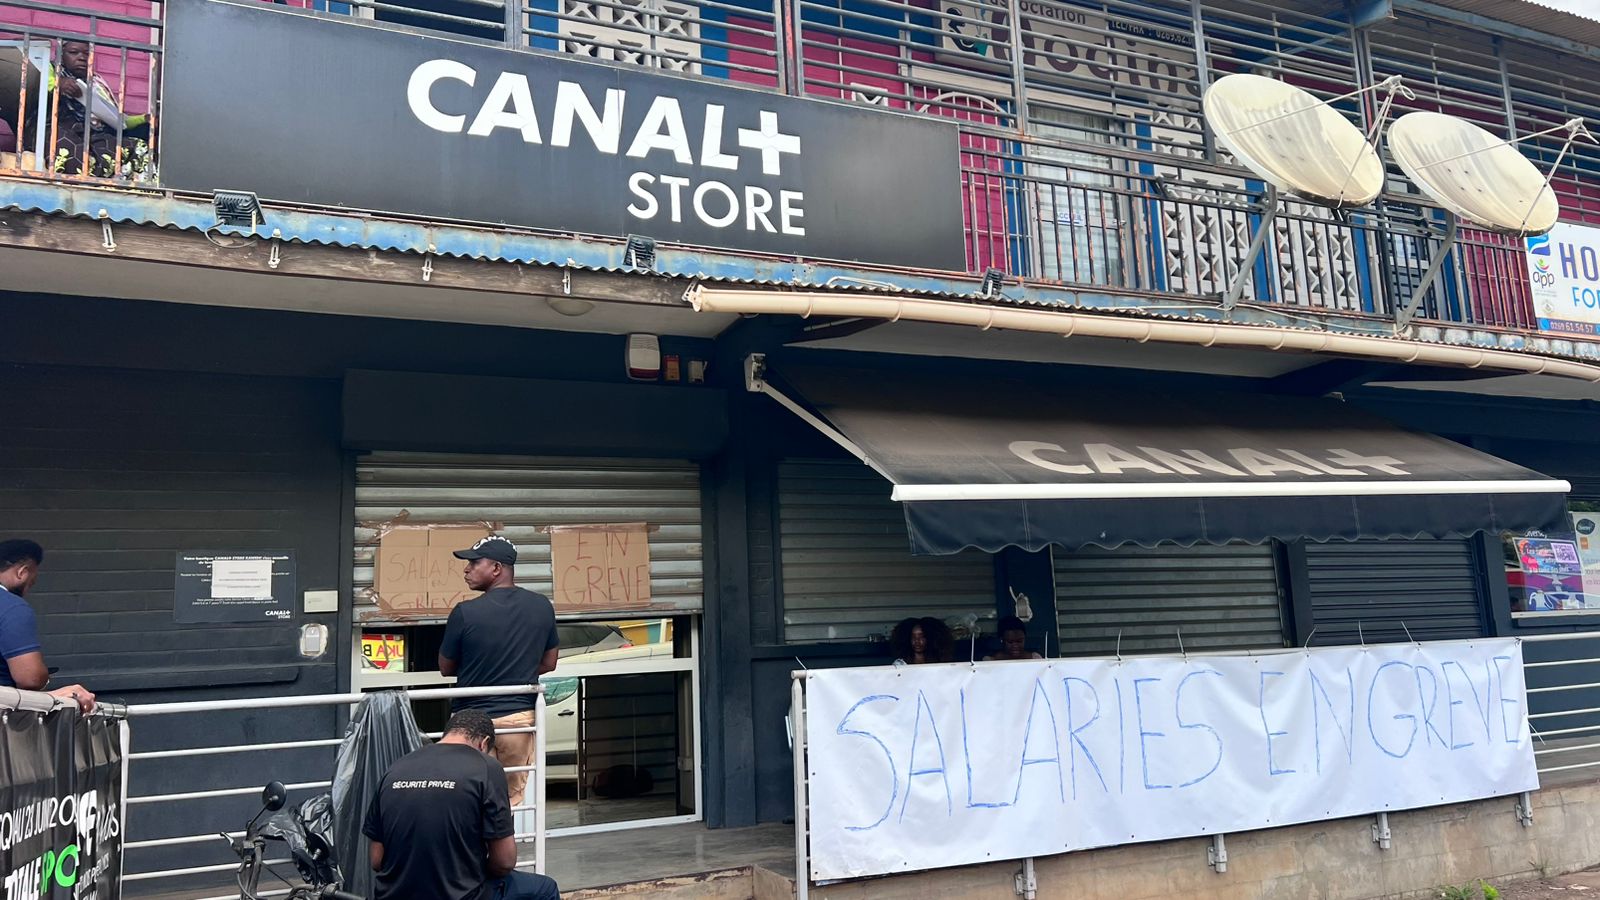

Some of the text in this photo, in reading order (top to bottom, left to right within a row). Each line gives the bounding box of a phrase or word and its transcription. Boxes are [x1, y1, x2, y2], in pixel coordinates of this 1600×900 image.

[991, 0, 1086, 25] sociation
[407, 59, 800, 175] CANAL+
[627, 171, 806, 236] STORE
[1533, 271, 1555, 288] app
[1008, 441, 1411, 476] CANAL+
[387, 553, 465, 582] SALAR
[563, 564, 650, 605] GREVE
[837, 656, 1521, 831] SALARIES EN GREVE
[428, 780, 456, 789] PRIVÉE
